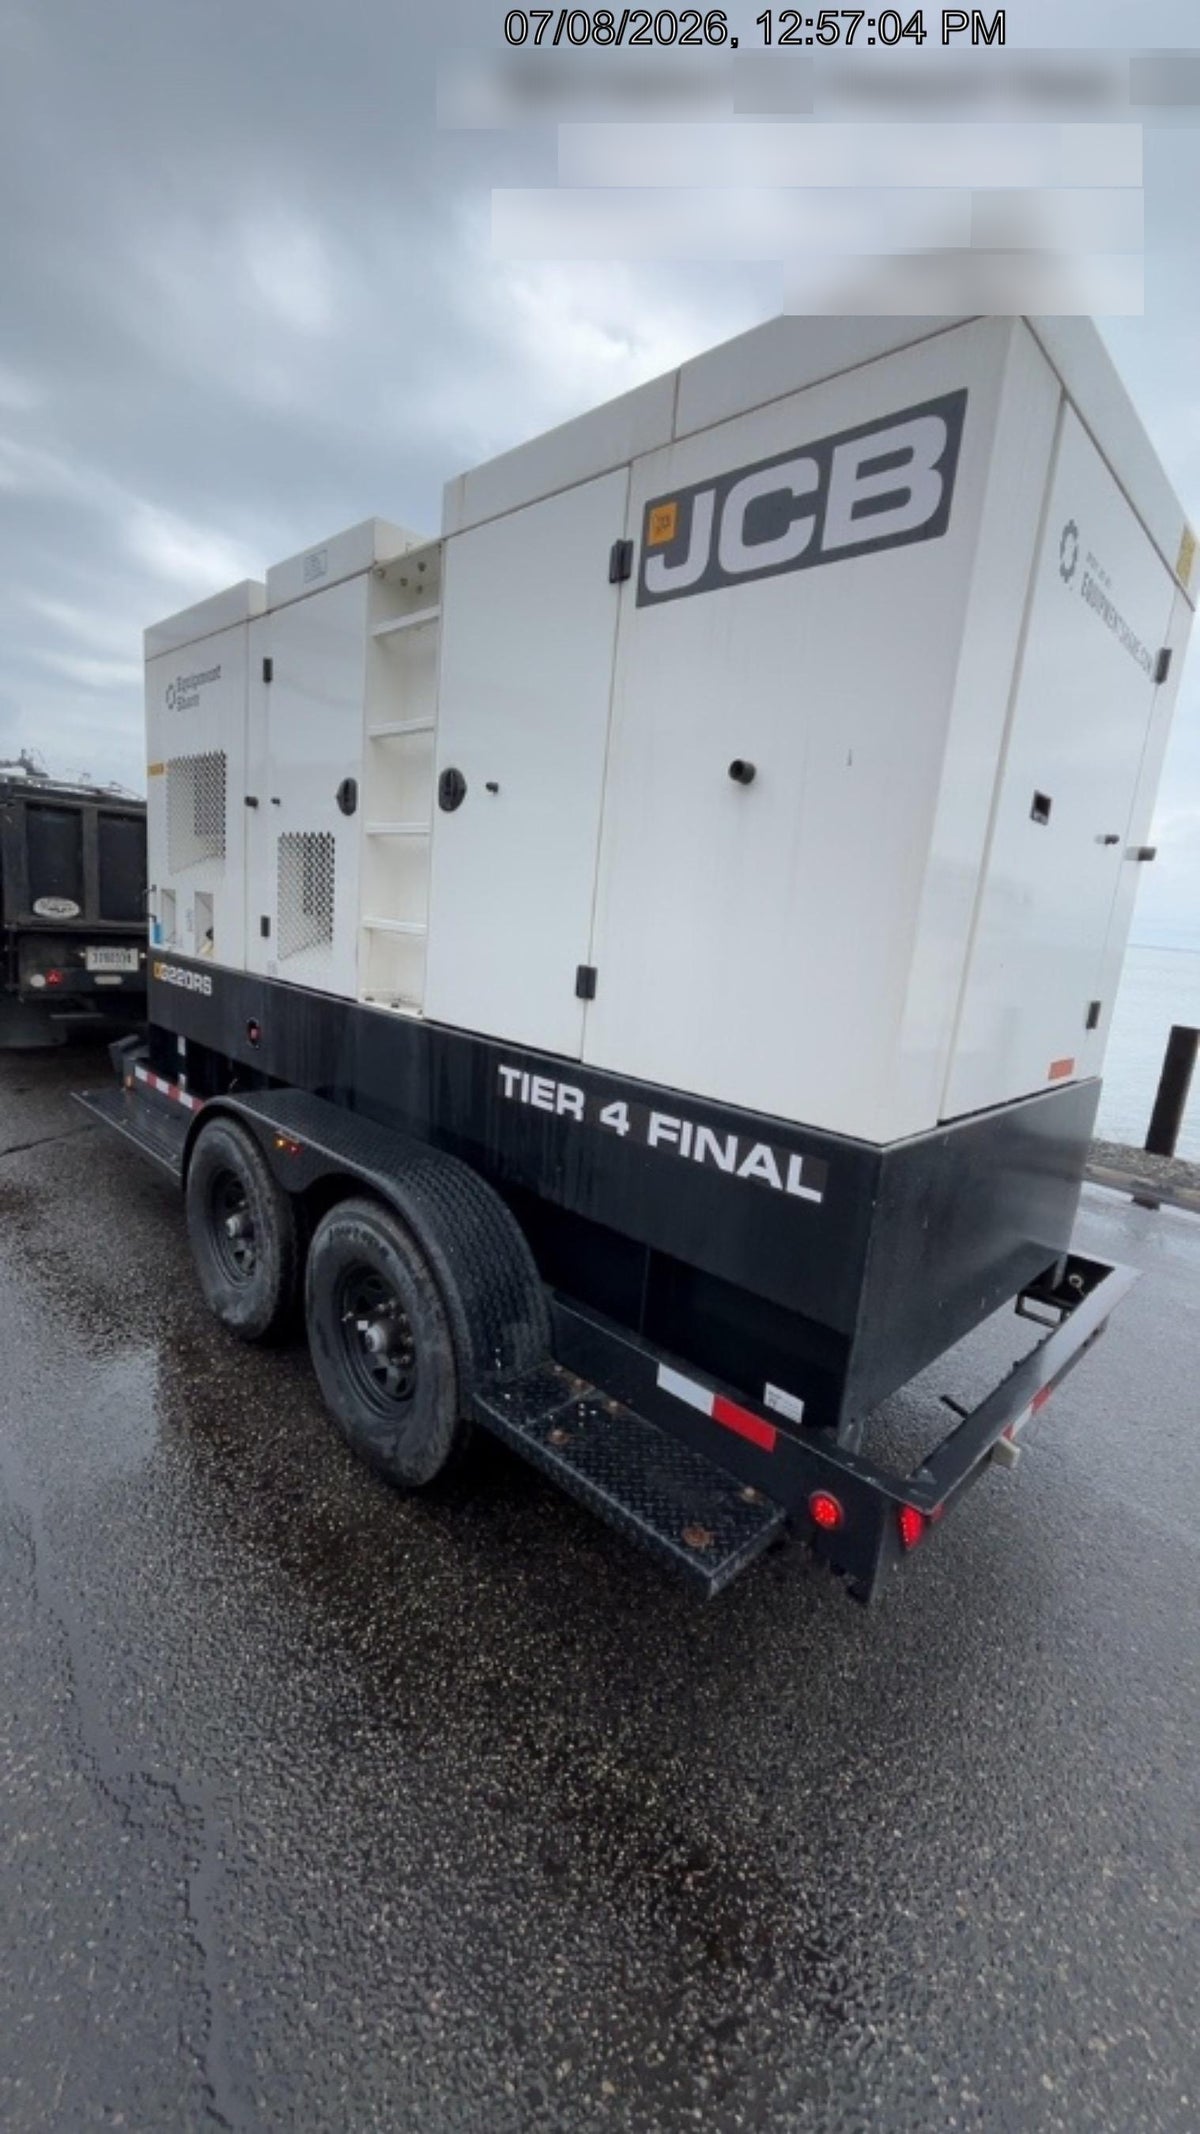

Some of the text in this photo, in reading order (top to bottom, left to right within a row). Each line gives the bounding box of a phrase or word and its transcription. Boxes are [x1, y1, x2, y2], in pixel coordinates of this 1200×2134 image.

[644, 414, 948, 594] JCB
[497, 1064, 823, 1203] TIER 4 FINAL
